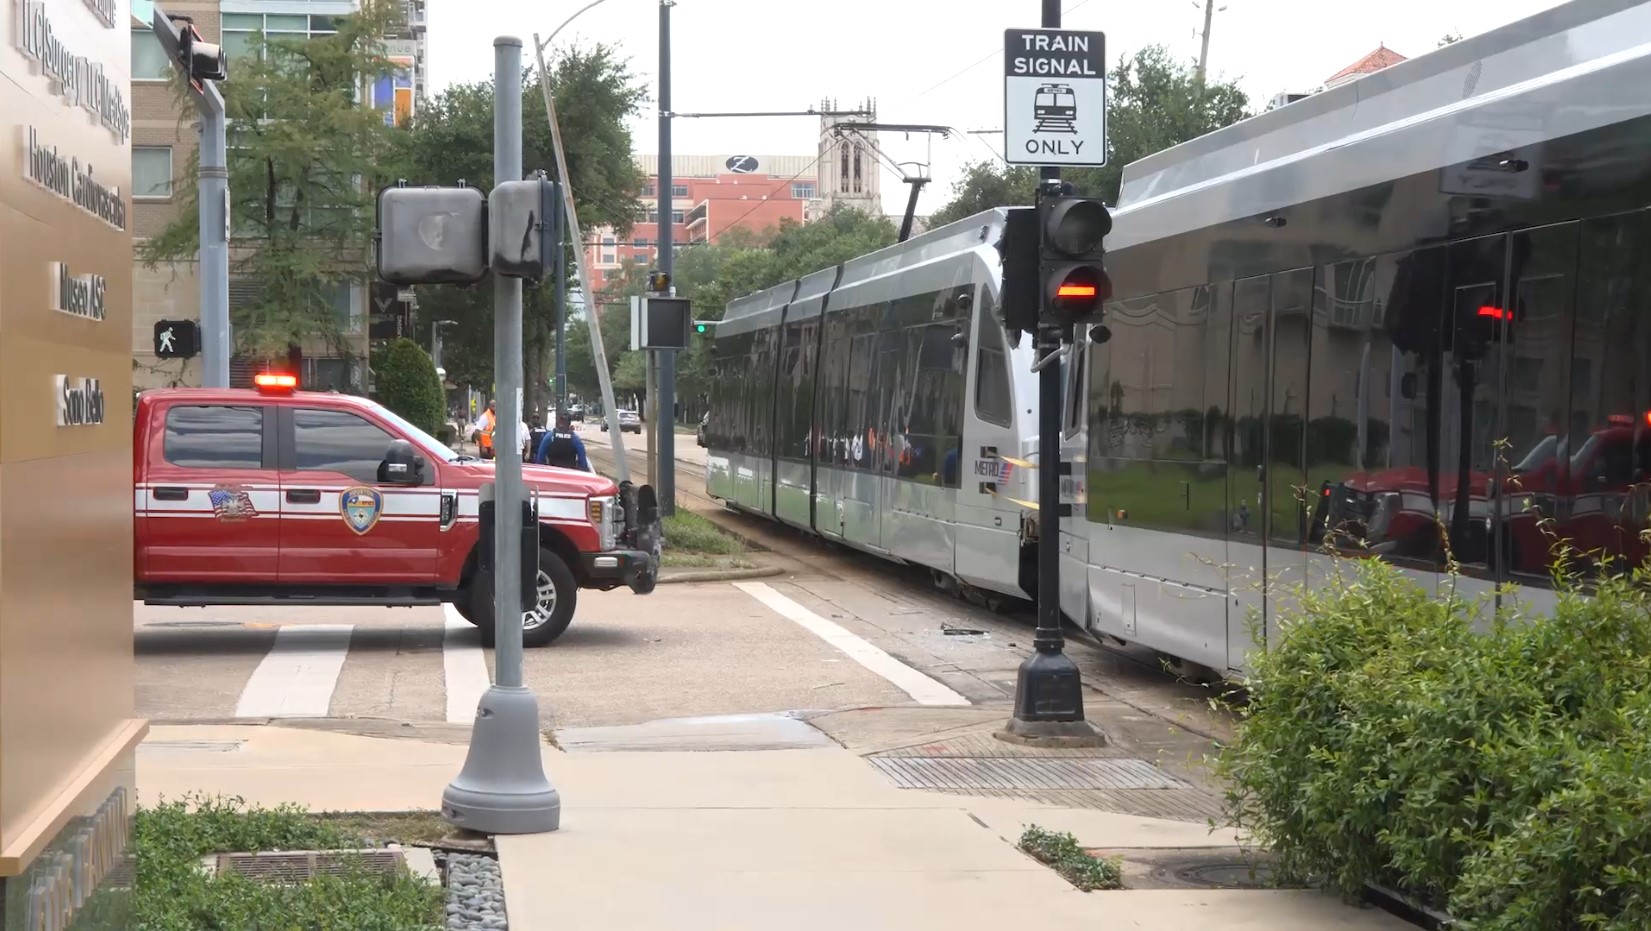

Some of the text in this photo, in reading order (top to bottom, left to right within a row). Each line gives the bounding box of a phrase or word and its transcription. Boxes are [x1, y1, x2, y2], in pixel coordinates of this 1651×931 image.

[1021, 34, 1088, 52] TRAIN
[1013, 57, 1096, 75] SIGNAL
[1025, 139, 1084, 155] ONLY
[29, 124, 69, 198] Houston
[59, 261, 106, 321] Museo ASC
[63, 375, 84, 426] Sono
[974, 460, 999, 477] METRO
